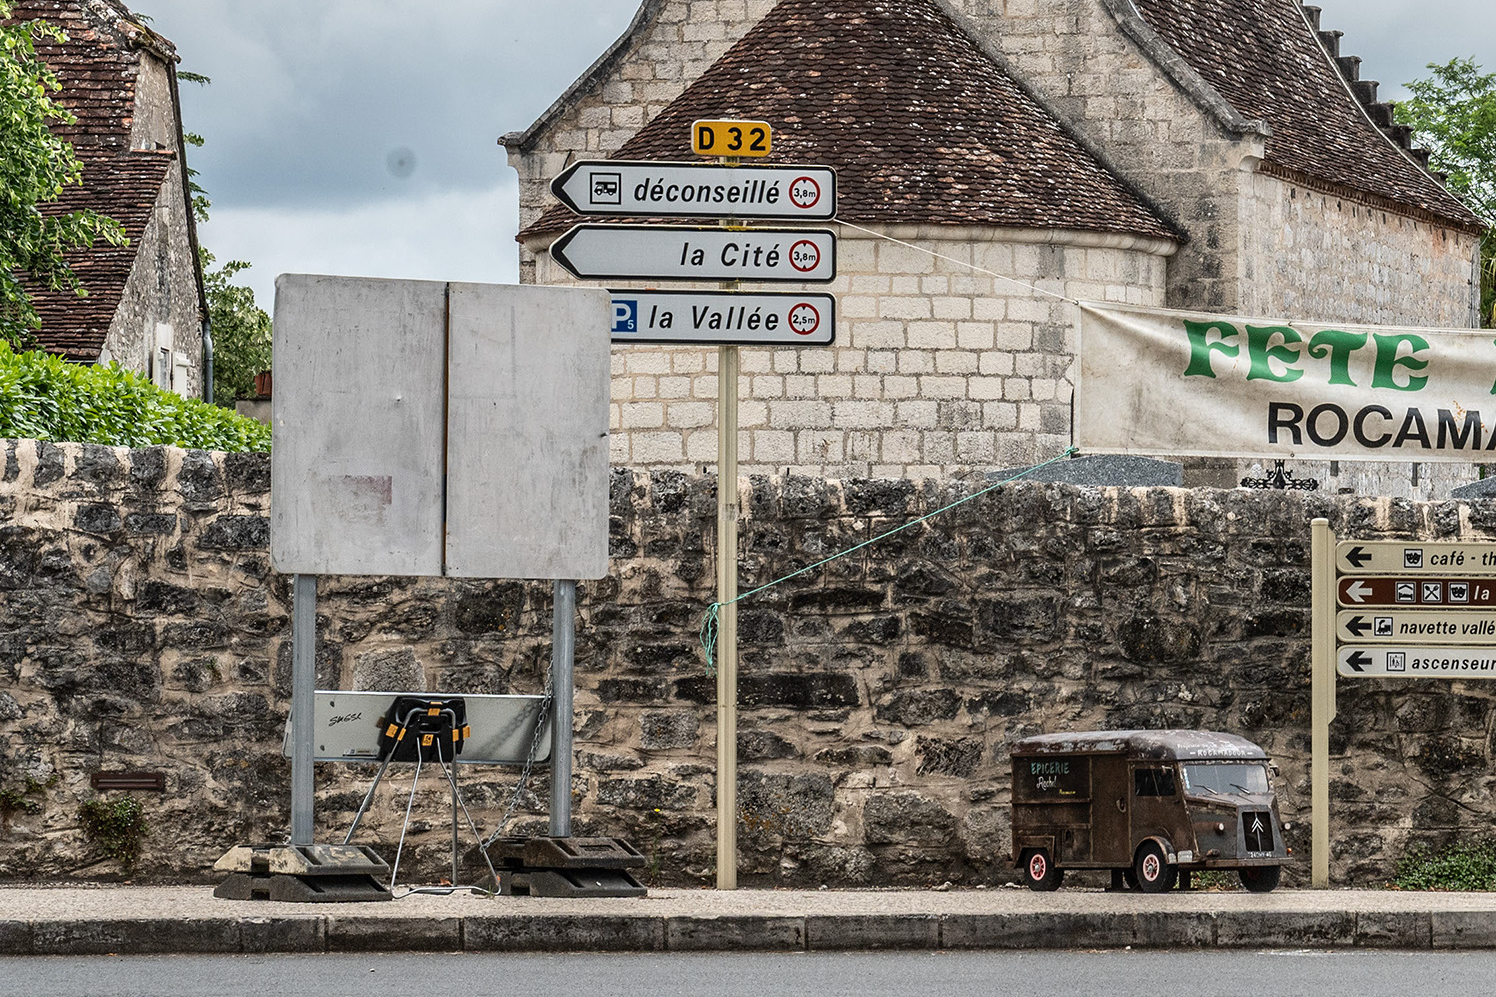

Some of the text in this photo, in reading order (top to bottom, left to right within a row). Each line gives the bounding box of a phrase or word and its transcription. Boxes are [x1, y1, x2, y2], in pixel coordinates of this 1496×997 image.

[698, 127, 766, 151] D 32
[634, 178, 816, 204] déconseillé 3,8m
[681, 242, 816, 267] la Cité 3,8m
[649, 305, 673, 329] la
[692, 305, 779, 331] Vallée
[792, 313, 816, 325] 2,5m
[1183, 319, 1431, 392] FETE
[1430, 551, 1465, 566] café
[1474, 585, 1490, 600] la
[1400, 621, 1457, 635] navette
[1411, 657, 1496, 670] ascenseur
